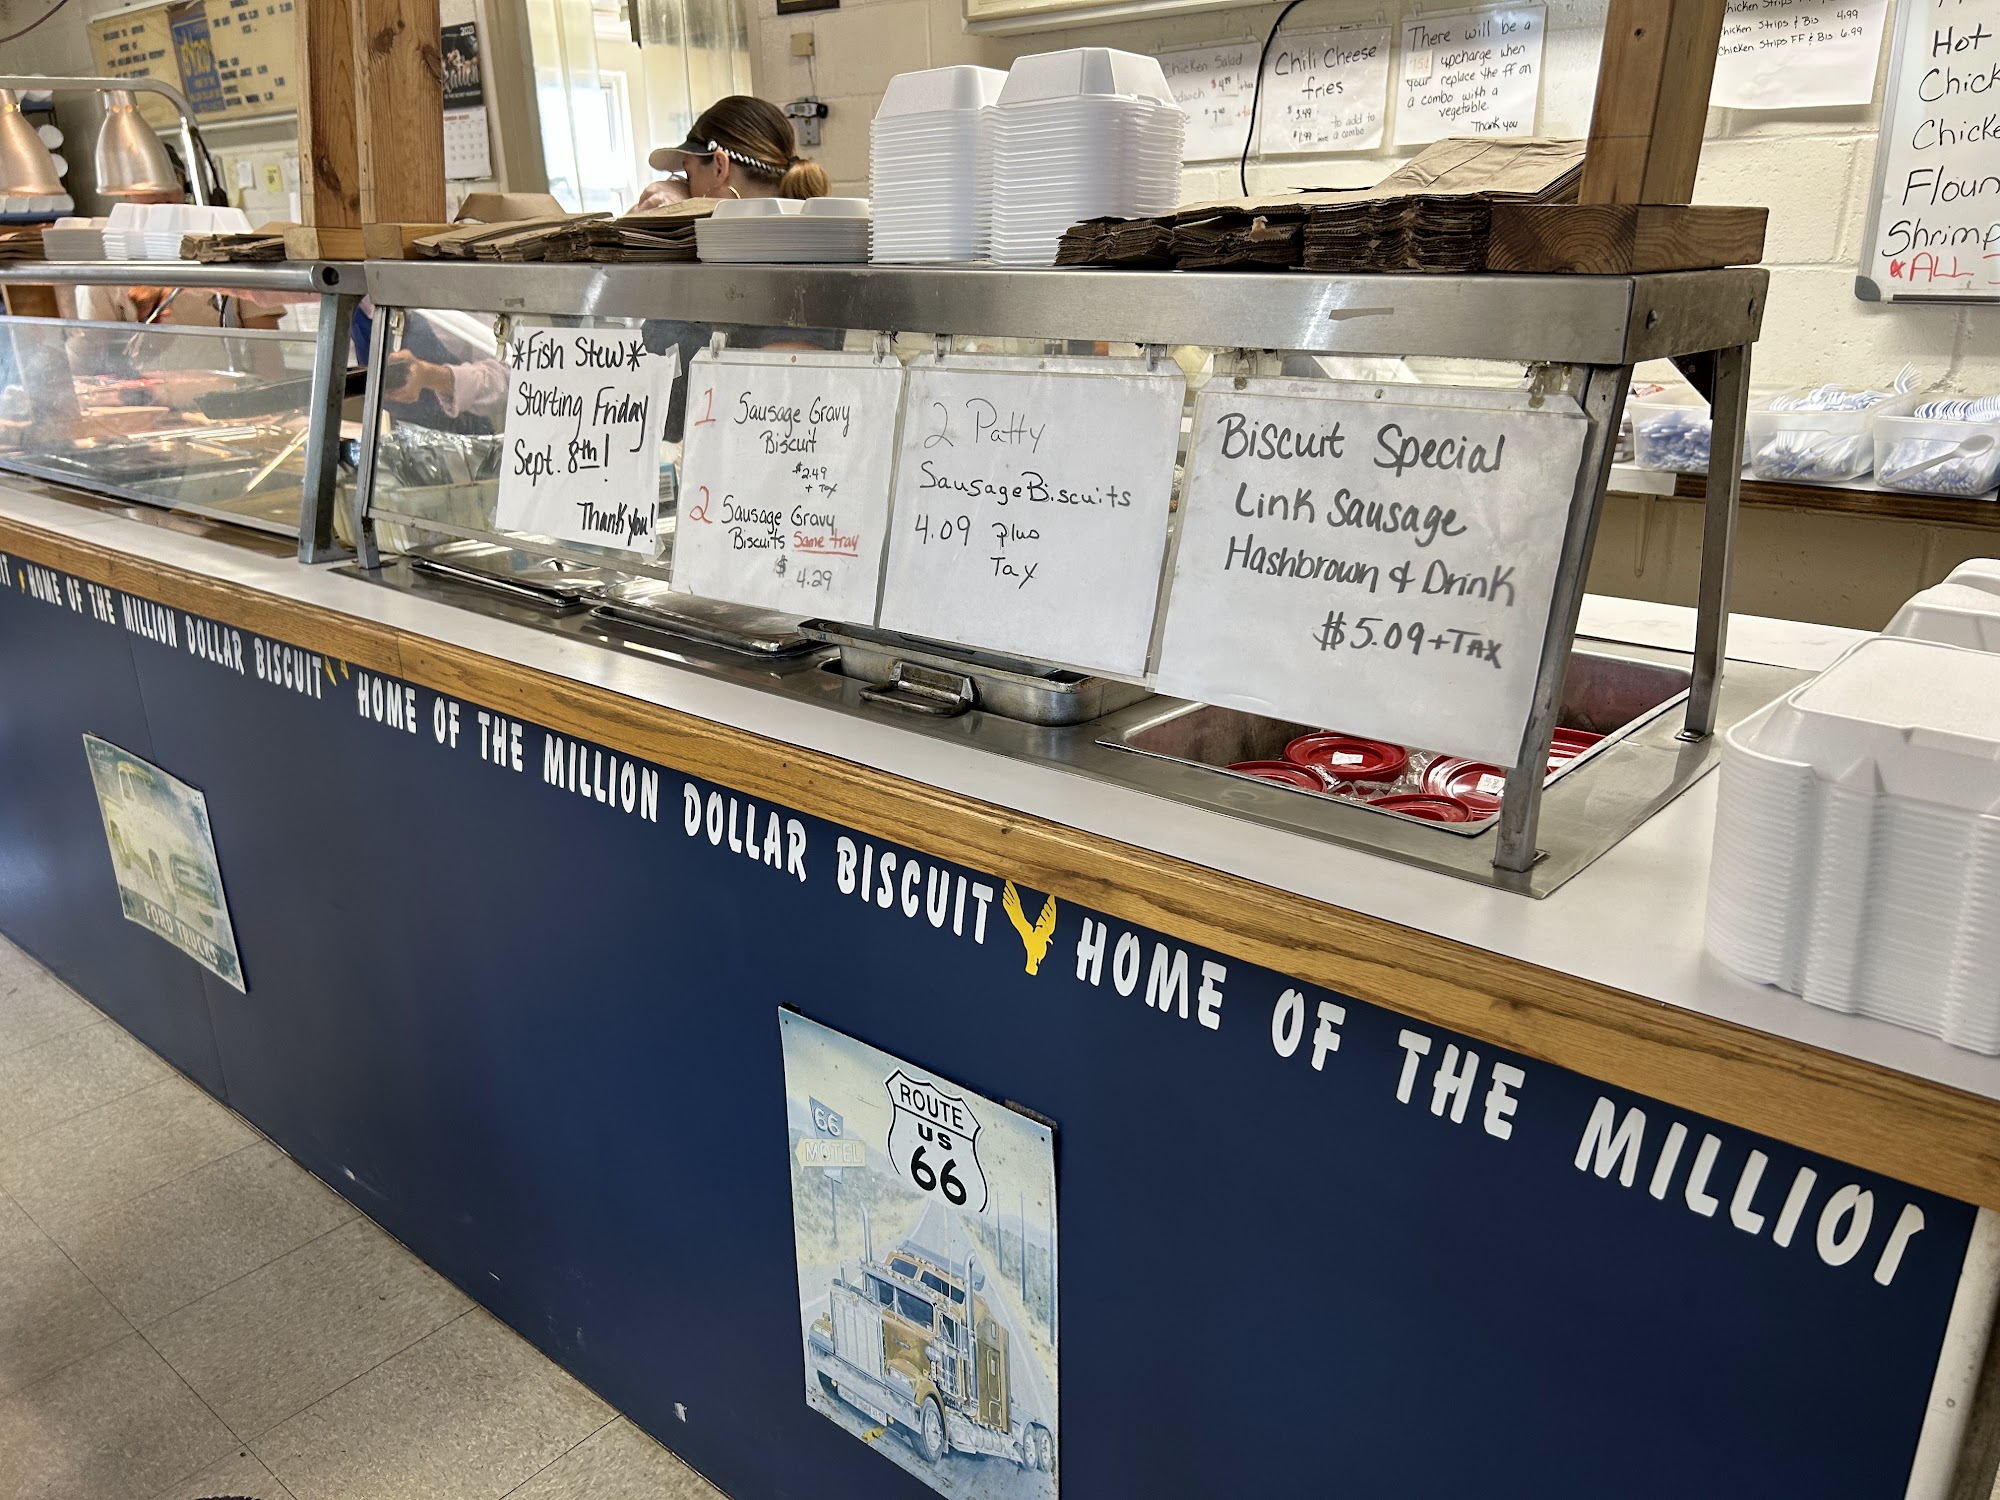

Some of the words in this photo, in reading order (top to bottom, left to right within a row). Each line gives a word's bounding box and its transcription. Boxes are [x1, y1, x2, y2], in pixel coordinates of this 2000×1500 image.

[1721, 24, 1752, 36] hicken
[1758, 19, 1789, 30] Strips
[1802, 16, 1820, 27] Bis
[1837, 9, 1859, 20] 4.99
[1726, 1, 1759, 14] hicken
[1408, 26, 1451, 52] There
[1464, 20, 1490, 41] will
[1501, 19, 1517, 36] be
[1523, 21, 1532, 31] a
[1717, 44, 1755, 57] Chicken
[1759, 38, 1788, 50] Strips
[1791, 33, 1806, 44] FF
[1817, 32, 1834, 42] Bis
[1840, 26, 1863, 38] 6.99
[1932, 23, 1993, 58] Hot
[1163, 60, 1208, 79] Chicken
[1214, 53, 1243, 69] Salad
[1275, 47, 1317, 76] Chili
[1323, 45, 1377, 69] Cheese
[1440, 49, 1492, 70] upcharge
[1500, 43, 1526, 58] when
[1302, 76, 1344, 100] fries
[1440, 71, 1476, 88] replace
[1480, 67, 1499, 81] the
[1518, 63, 1532, 75] on
[1407, 96, 1415, 109] a
[1420, 90, 1454, 106] combo
[1462, 86, 1487, 101] with
[1491, 87, 1499, 97] a
[1331, 115, 1343, 129] to
[1345, 113, 1363, 127] add
[1365, 112, 1376, 123] to
[1341, 127, 1365, 138] combo
[1471, 117, 1500, 133] Thank
[1502, 119, 1519, 133] you
[516, 381, 583, 441] Starting
[592, 386, 650, 452] Friday
[694, 388, 716, 426] 1
[733, 392, 802, 439] Sausage
[808, 396, 851, 437] Gravy
[924, 402, 954, 449] 2
[965, 398, 1046, 454] Patty
[759, 427, 818, 454] Biscuit
[1216, 412, 1345, 460] Biscuit
[1373, 423, 1506, 474] Special
[514, 433, 562, 487] Sept.
[792, 461, 828, 480] $2.49
[818, 483, 838, 498] Tax
[577, 502, 629, 536] Thank
[627, 503, 656, 547] you!
[689, 485, 713, 524] 2
[721, 495, 782, 535] Sausage
[790, 505, 836, 535] Gravy
[1234, 484, 1317, 524] Link
[1326, 496, 1467, 549] Sausage
[728, 526, 786, 550] Biscuits
[793, 531, 825, 549] Same
[829, 528, 860, 551] tray
[915, 514, 971, 547] 4.09
[991, 522, 1040, 548] plus
[796, 568, 833, 591] 4.29
[990, 556, 1039, 590] Tax
[1223, 534, 1379, 594] Hashbrown
[1421, 558, 1516, 607] Drink
[27, 564, 63, 606] HOME
[66, 575, 83, 614] OF
[87, 582, 116, 625] THE
[121, 594, 178, 649] MILLION
[185, 614, 245, 676] DOLLAR
[254, 637, 323, 700] BISCUIT
[356, 671, 418, 735] HOME
[433, 696, 462, 750] OF
[477, 711, 525, 773] THE
[543, 732, 660, 824] MILLION
[682, 782, 808, 883] DOLLAR
[835, 835, 995, 946] BISCUIT
[144, 901, 174, 935] FORD
[175, 920, 220, 966] TRUCKS
[1076, 917, 1228, 1032] HOME
[1270, 987, 1347, 1072] OF
[1395, 1028, 1527, 1142] THE
[814, 1107, 842, 1137] 66
[899, 1082, 964, 1131] ROUTE
[917, 1121, 953, 1151] US
[804, 1139, 863, 1165] MOTEL
[910, 1145, 967, 1206] 66
